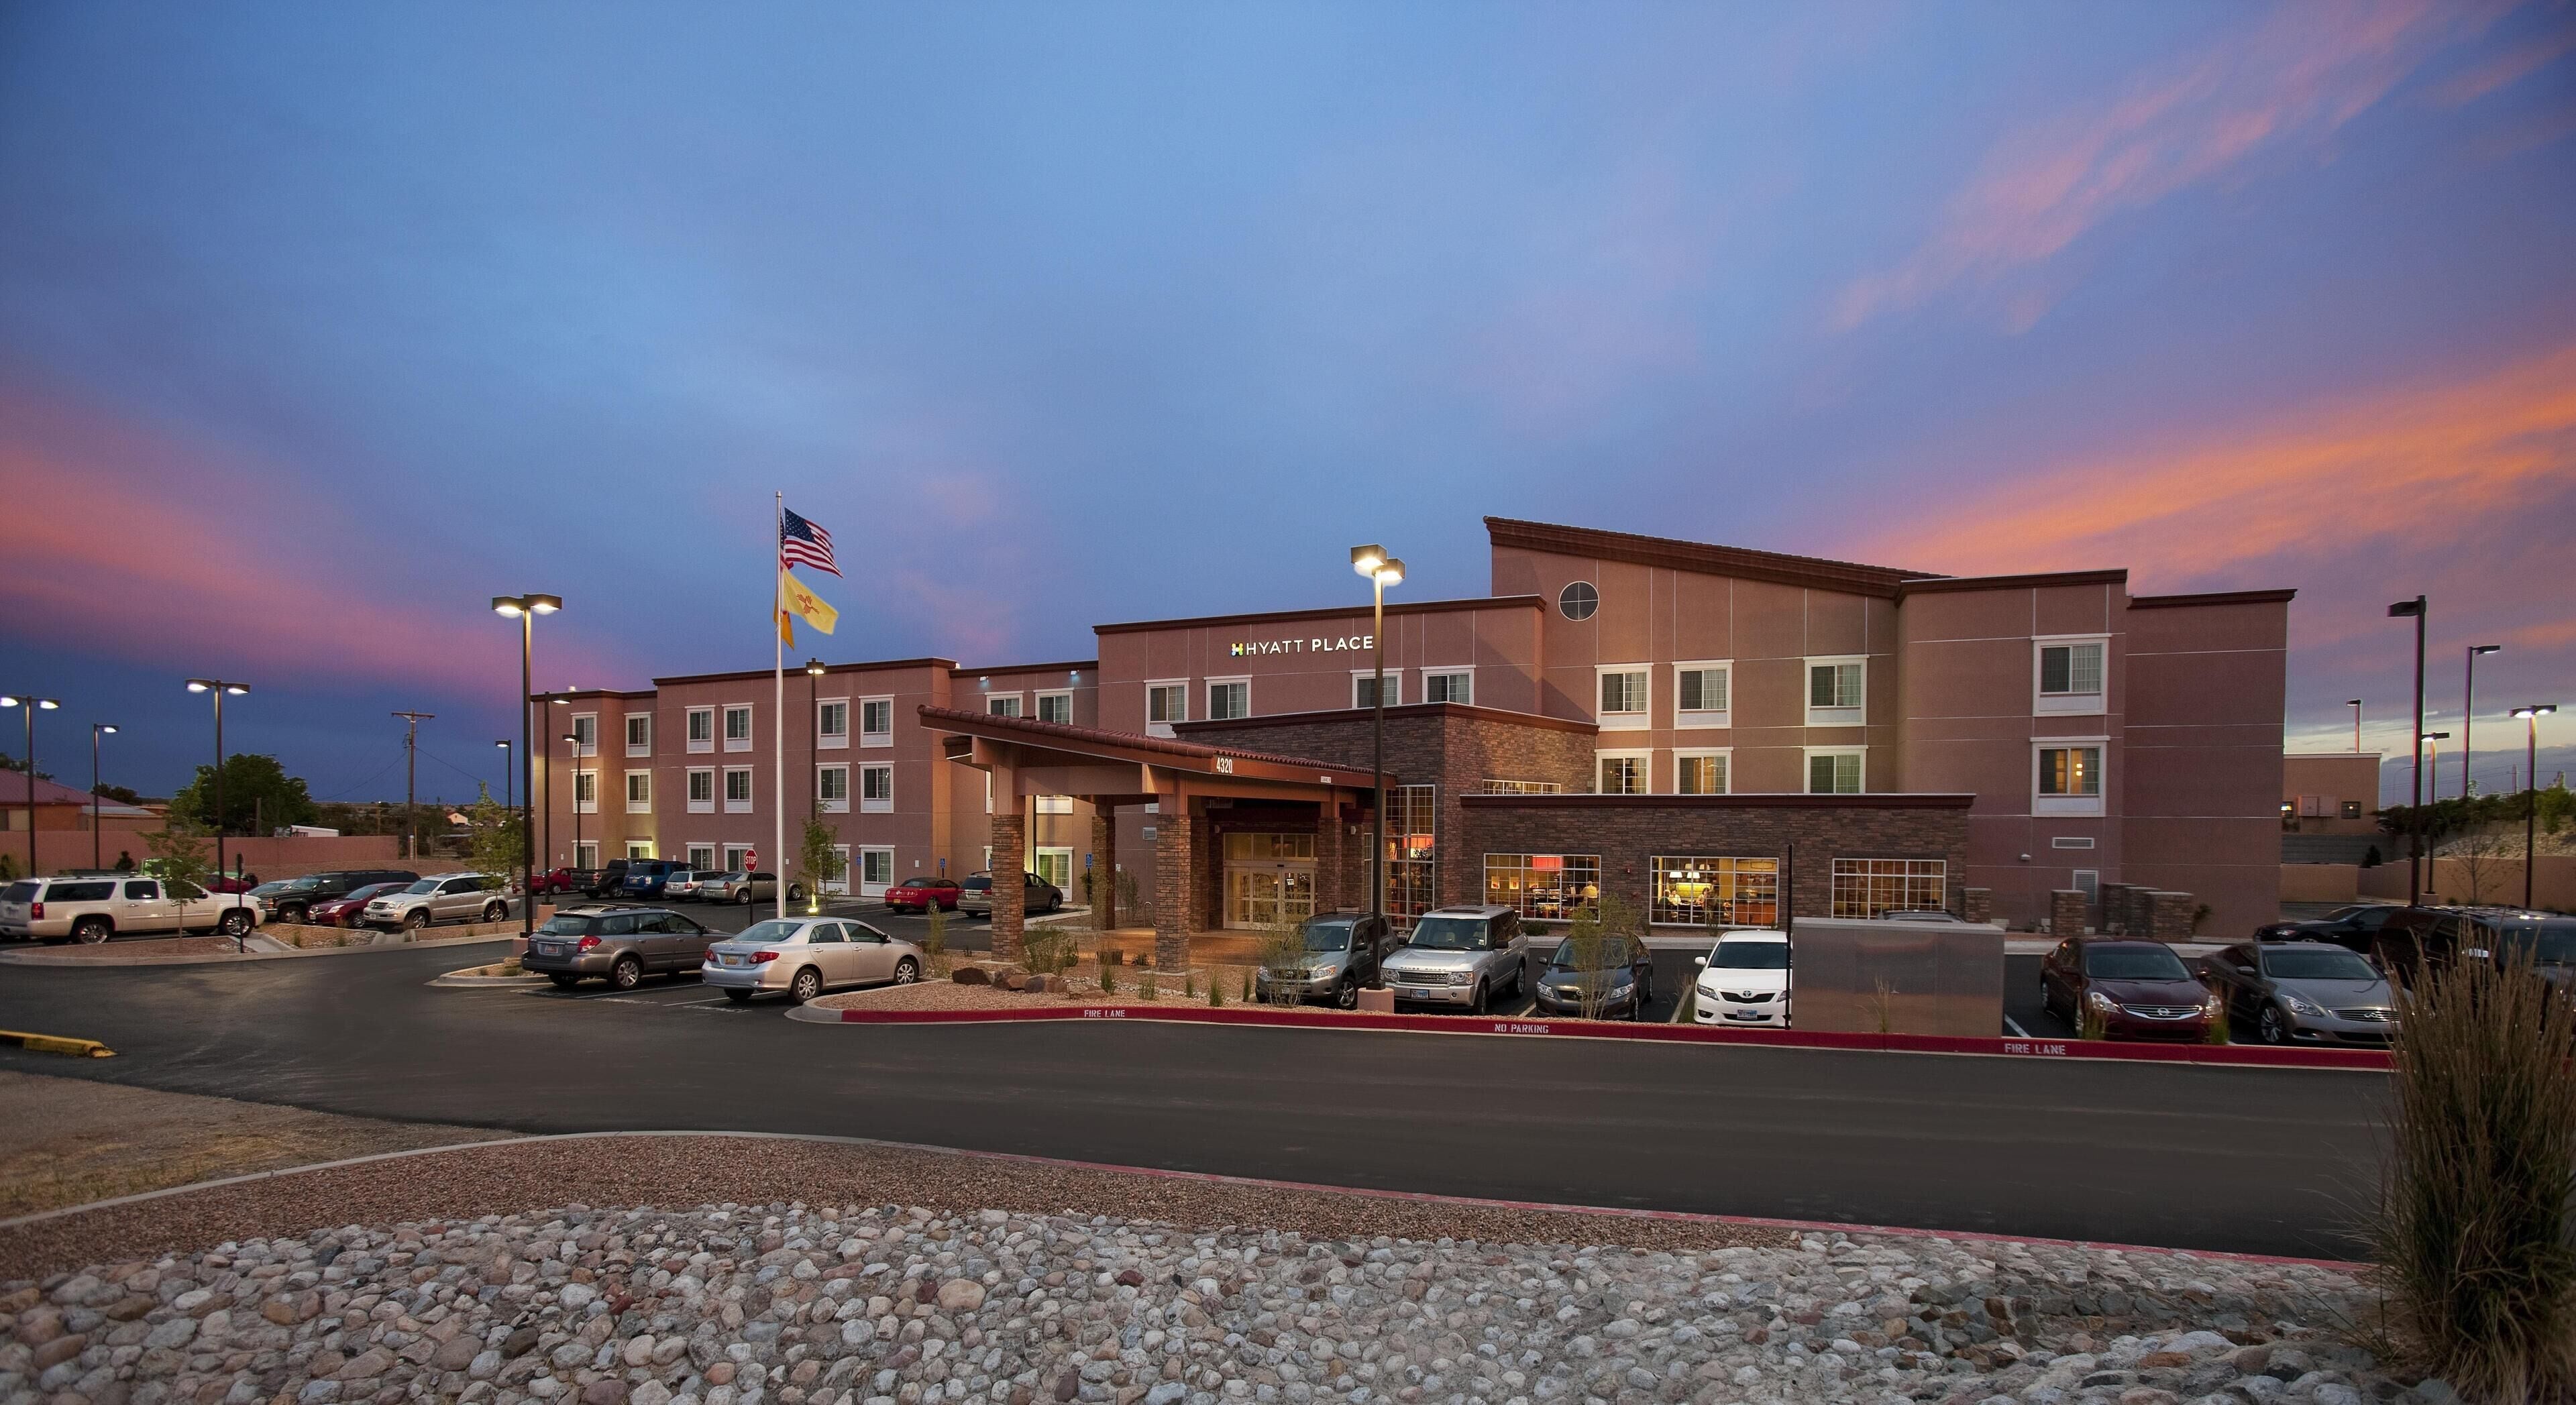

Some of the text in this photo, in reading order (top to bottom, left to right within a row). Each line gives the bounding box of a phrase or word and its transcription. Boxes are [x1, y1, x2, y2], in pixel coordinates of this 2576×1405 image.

[1246, 636, 1374, 655] HYATT PLACE
[1216, 757, 1233, 774] 4320
[745, 856, 757, 864] STOP
[1084, 1009, 1126, 1017] FIRE LANE
[1495, 1023, 1549, 1033] NO PARKING
[2004, 1043, 2066, 1055] FIRE LANE
